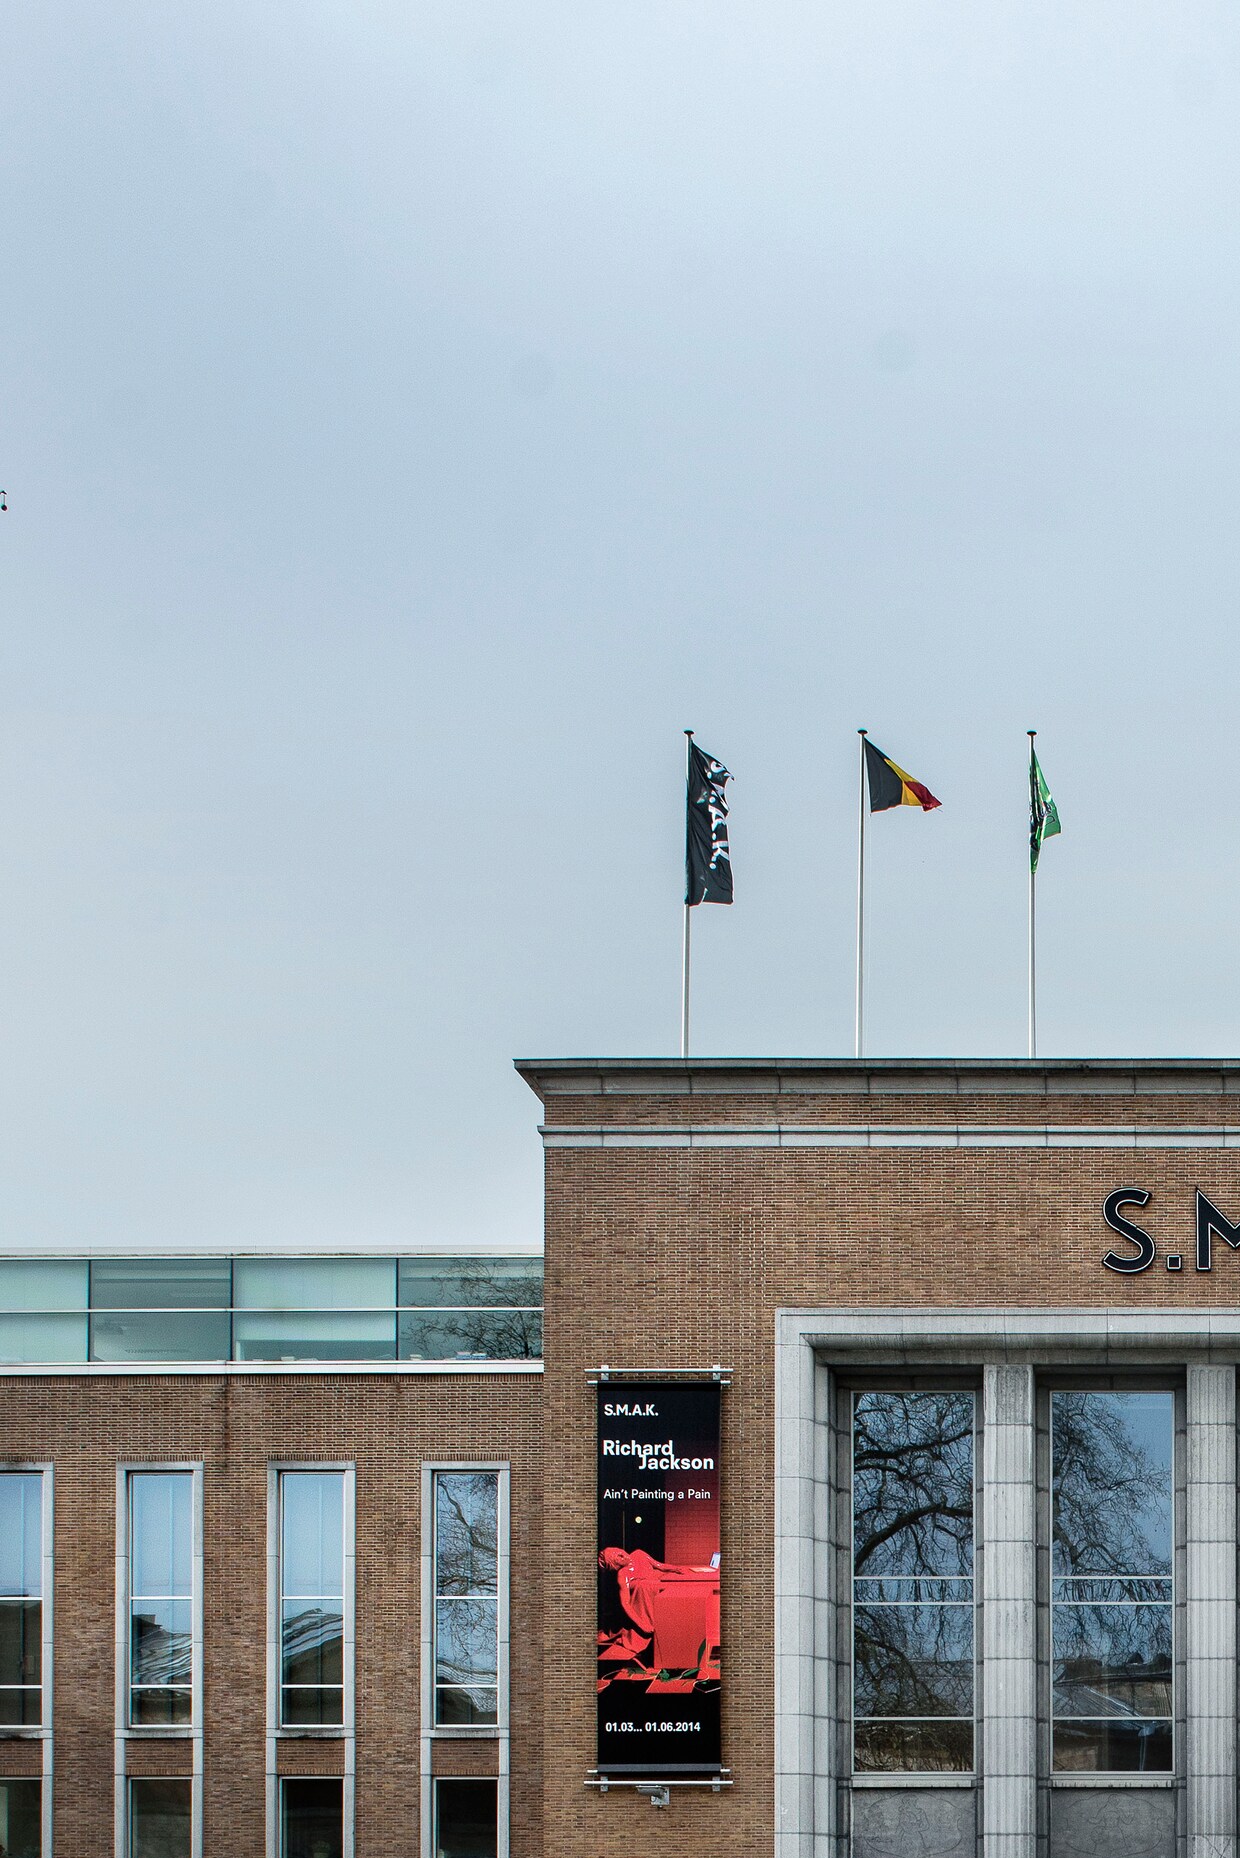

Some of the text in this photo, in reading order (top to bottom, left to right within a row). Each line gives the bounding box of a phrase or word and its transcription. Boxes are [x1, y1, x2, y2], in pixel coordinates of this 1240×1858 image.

[603, 1404, 659, 1416] S.M.A.K.
[603, 1440, 673, 1456] Richard
[638, 1453, 715, 1470] Jackson
[631, 1488, 675, 1501] Painting
[678, 1491, 685, 1499] a
[687, 1488, 711, 1499] Pain
[605, 1722, 701, 1732] 01.03... 01.06.2014
